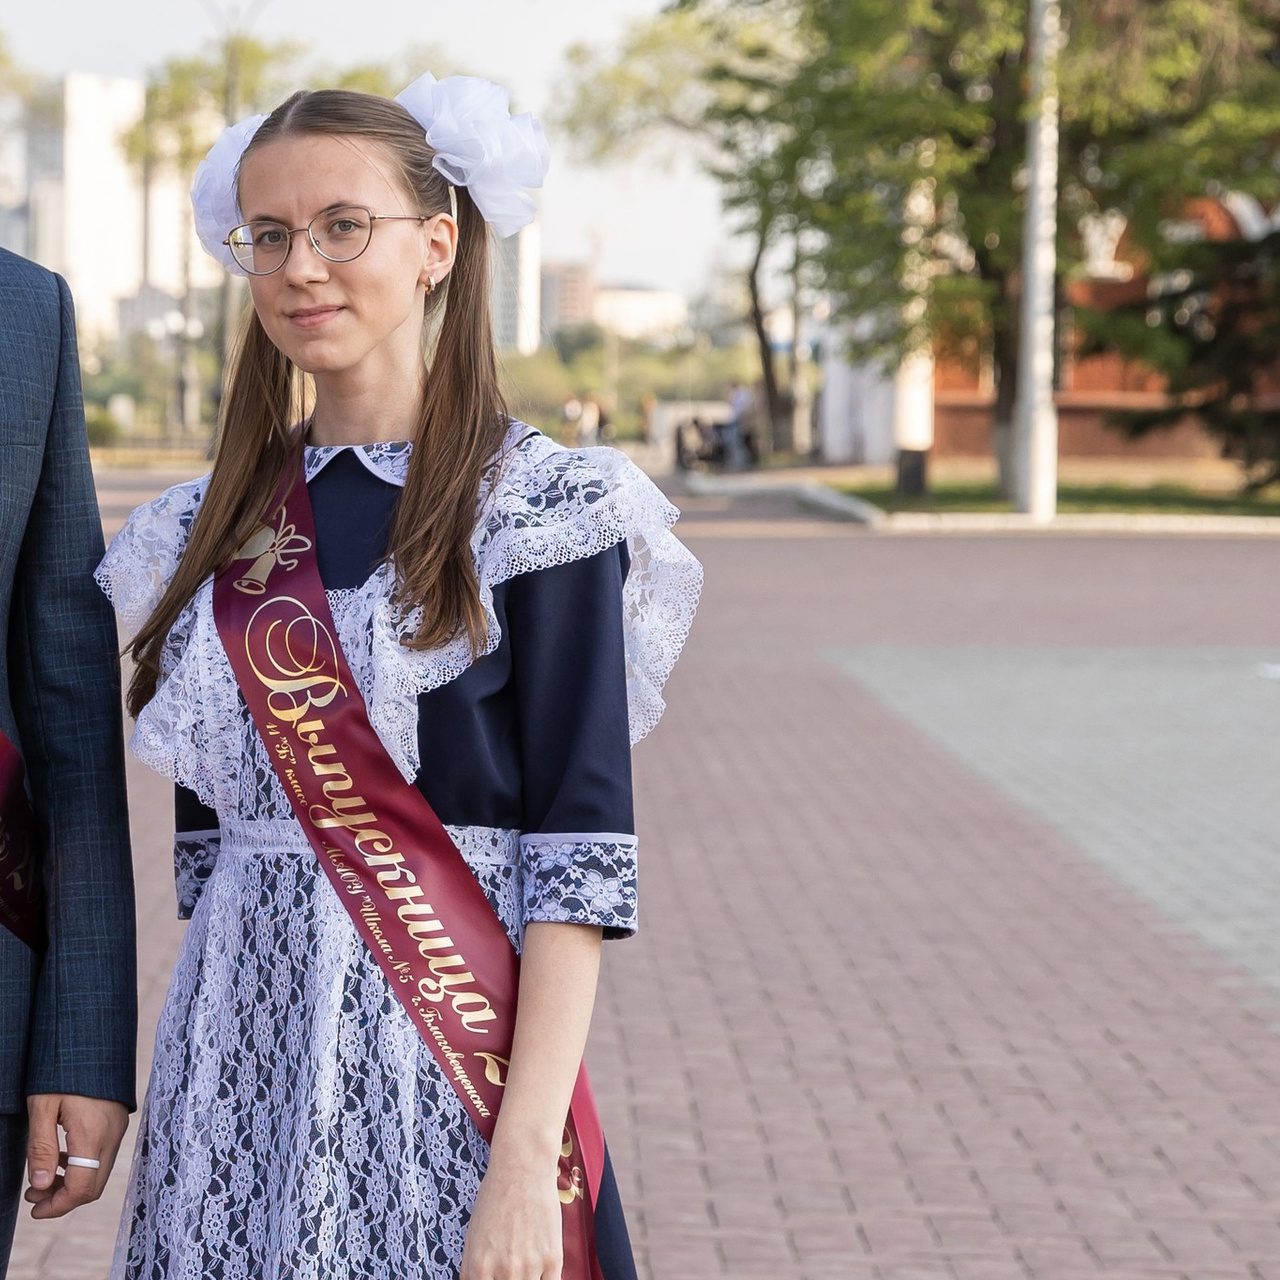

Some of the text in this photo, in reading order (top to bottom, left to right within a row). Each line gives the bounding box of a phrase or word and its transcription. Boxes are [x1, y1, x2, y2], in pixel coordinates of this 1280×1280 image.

[245, 596, 498, 1034] Выпускница
[266, 722, 281, 736] 11
[285, 769, 308, 806] класс
[321, 840, 366, 896] МАОУ
[388, 953, 415, 985] №5
[410, 994, 422, 1008] г.
[418, 1006, 492, 1119] Благовещенска
